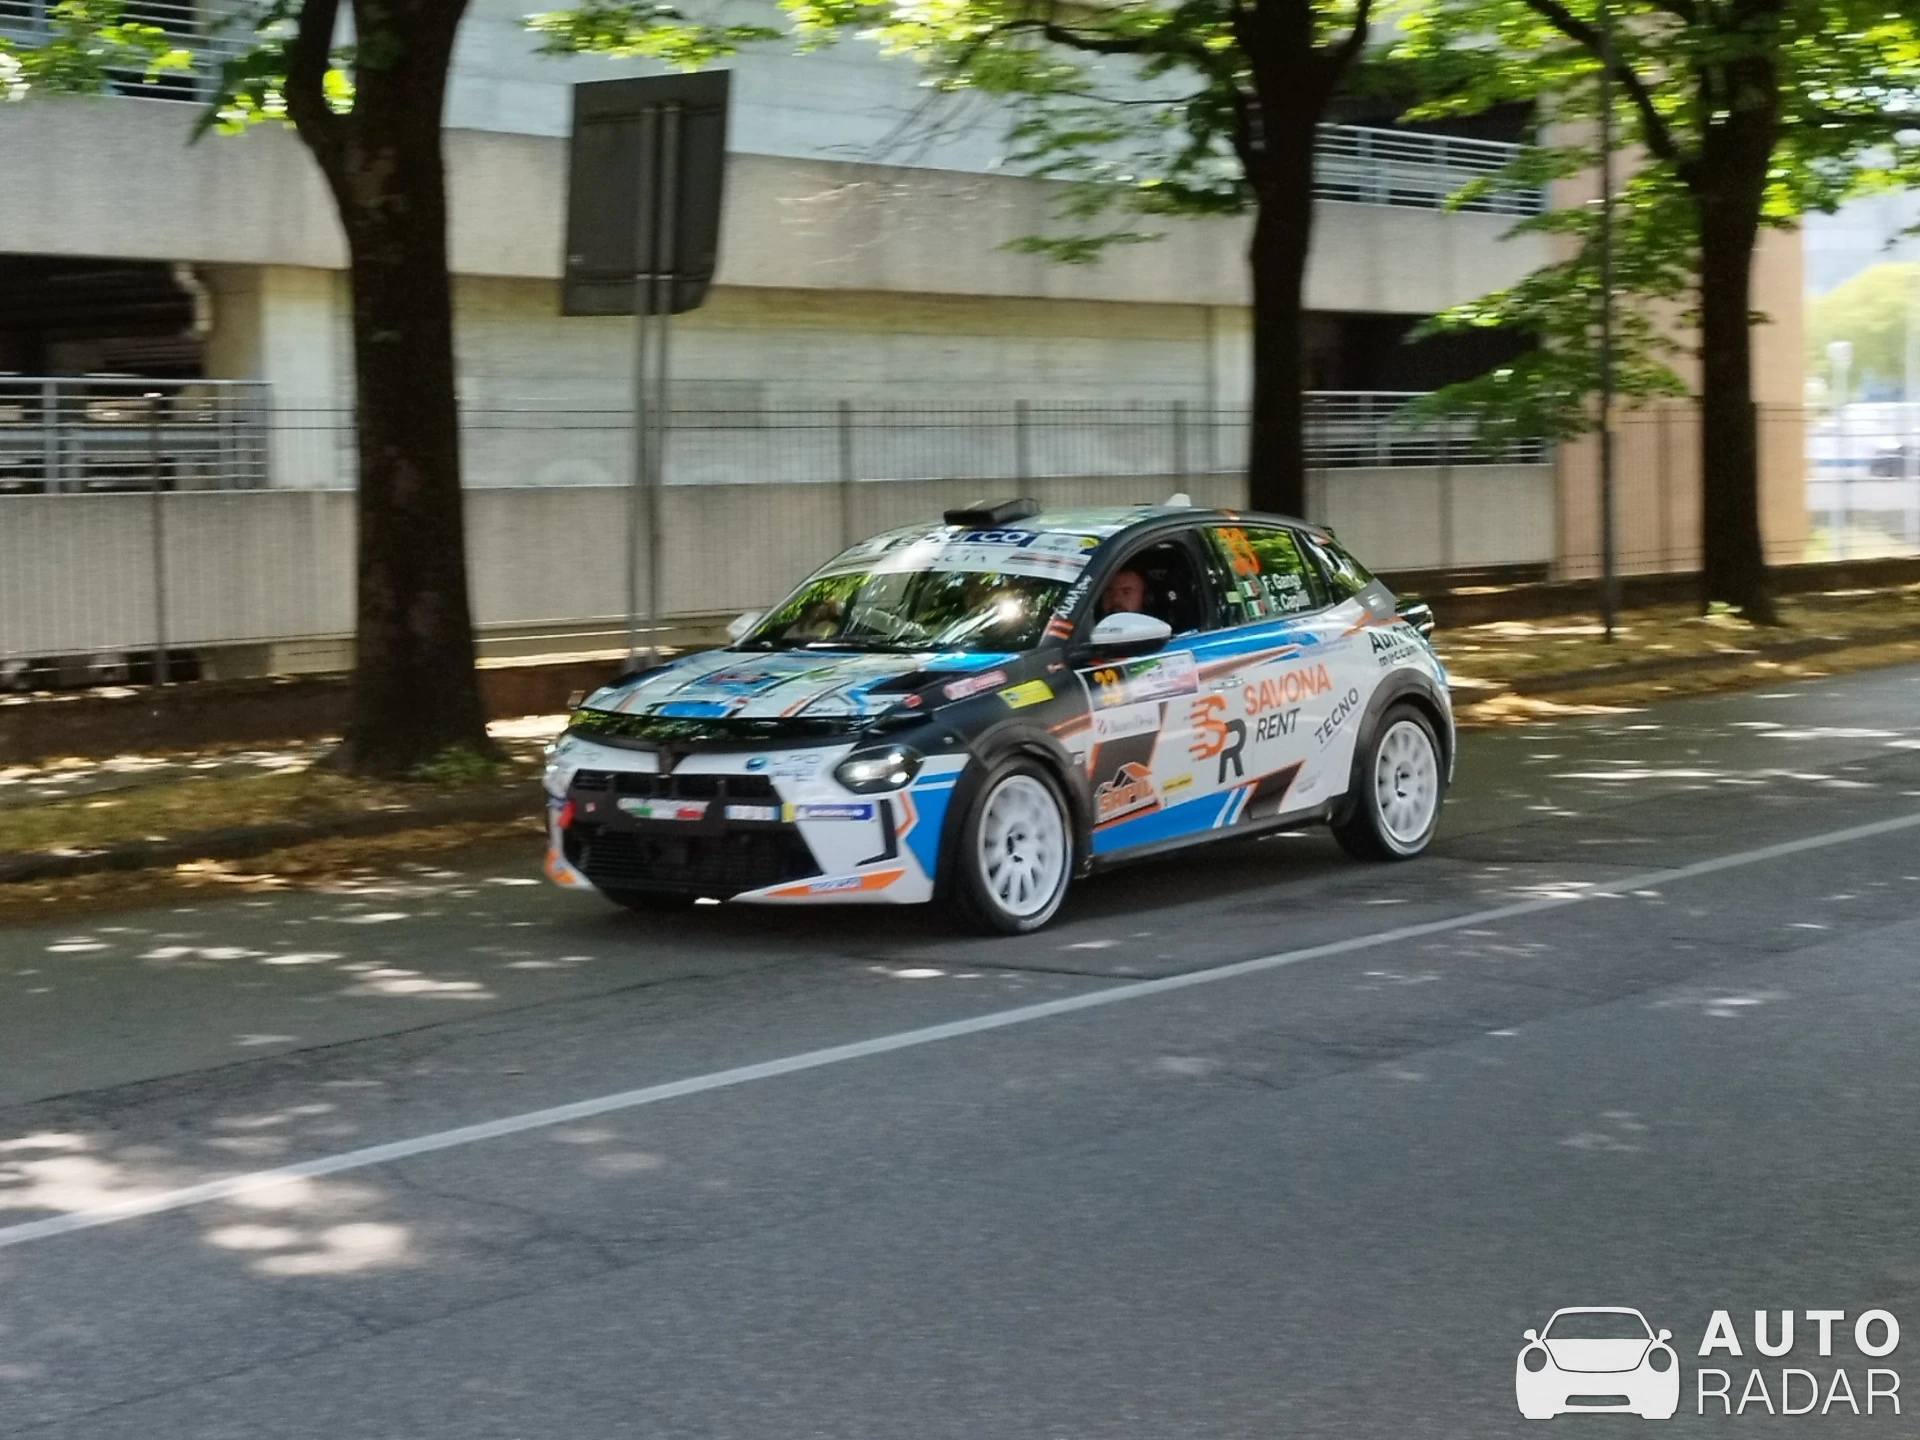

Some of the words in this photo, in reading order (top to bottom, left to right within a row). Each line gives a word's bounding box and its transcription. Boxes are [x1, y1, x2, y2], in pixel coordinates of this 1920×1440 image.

[1243, 663, 1332, 716] SAVONA
[1314, 687, 1359, 744] TECNO
[1256, 707, 1301, 743] RENT
